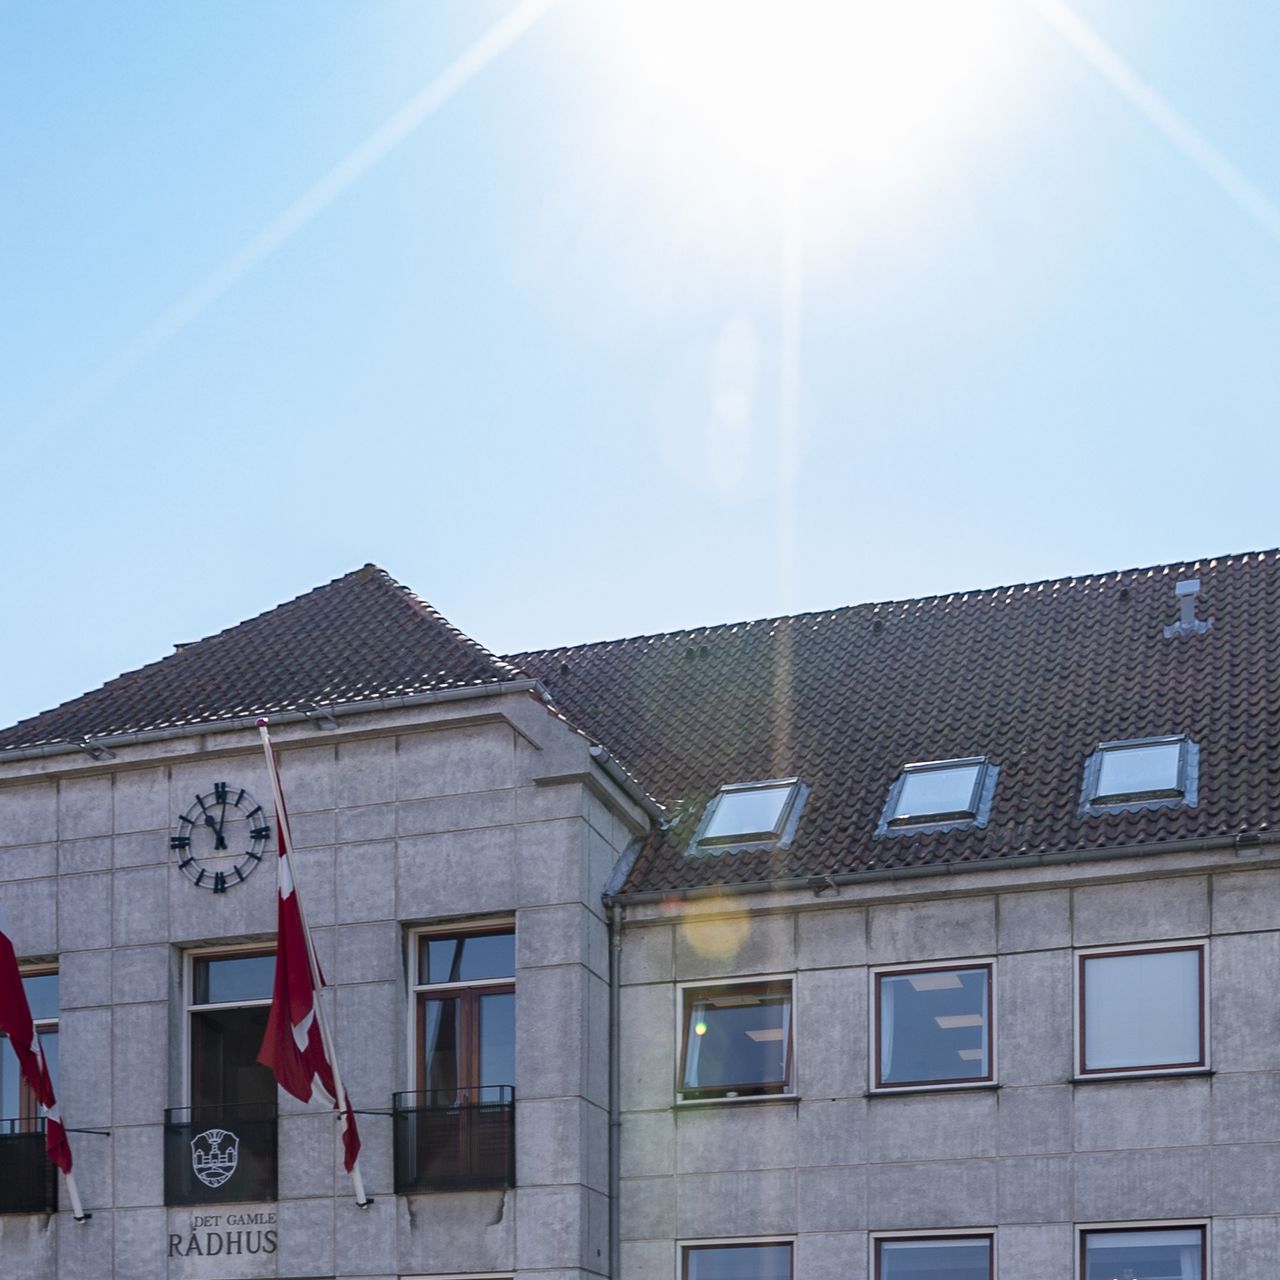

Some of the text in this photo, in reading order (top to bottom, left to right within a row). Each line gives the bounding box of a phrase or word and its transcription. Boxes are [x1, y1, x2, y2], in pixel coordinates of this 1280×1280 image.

[194, 1212, 277, 1228] DET GAMLE
[167, 1228, 278, 1257] RÅDHUS
